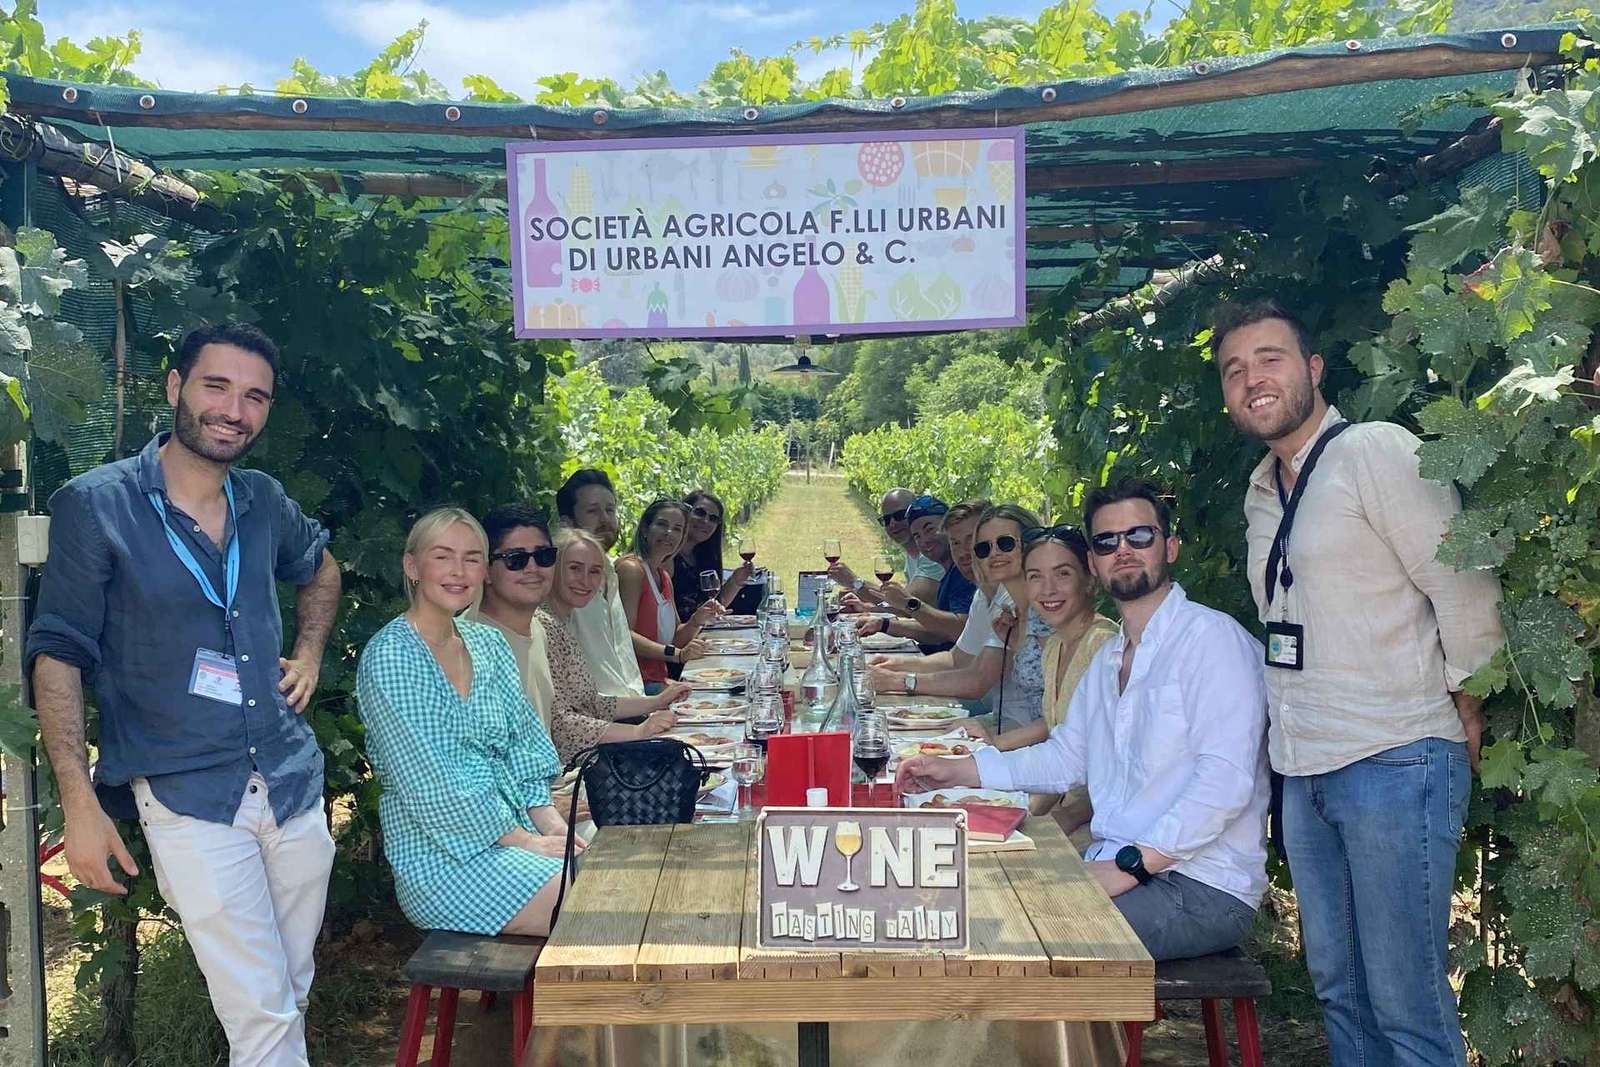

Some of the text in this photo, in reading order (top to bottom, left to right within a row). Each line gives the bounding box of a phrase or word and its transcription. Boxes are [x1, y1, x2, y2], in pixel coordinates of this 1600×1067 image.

[529, 204, 1006, 242] SOCIETÀ AGRICOLA F.LLI URBANI
[569, 239, 916, 271] DI URBANI ANGELO & C.
[774, 909, 874, 938] TASTING
